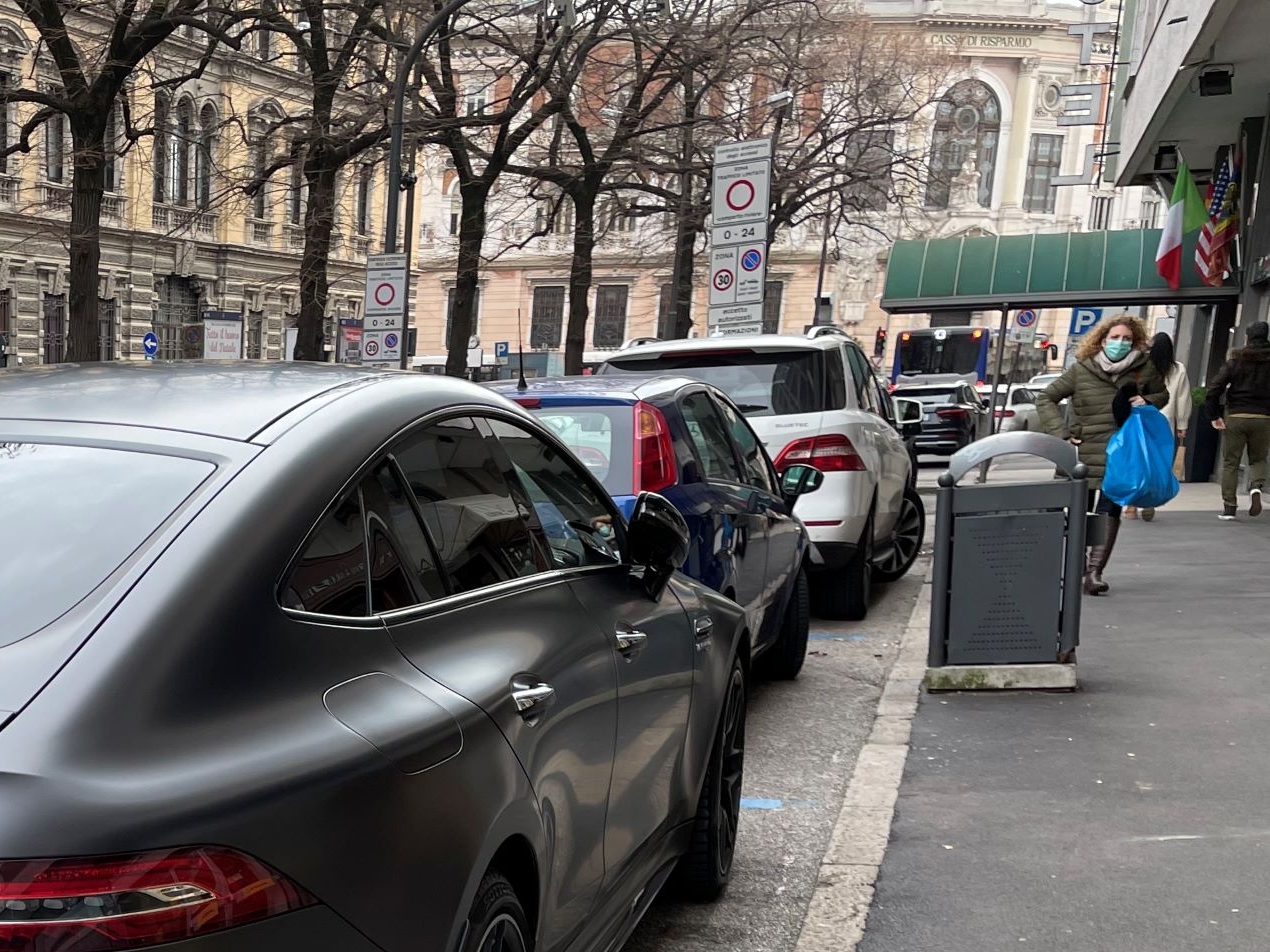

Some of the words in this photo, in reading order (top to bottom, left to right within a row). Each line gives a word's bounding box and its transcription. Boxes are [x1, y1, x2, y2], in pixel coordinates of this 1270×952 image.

[967, 36, 977, 46] DI
[980, 37, 1032, 48] RISPARMIO
[724, 230, 731, 239] 0
[741, 227, 755, 237] 24
[717, 274, 730, 286] 30
[1074, 310, 1097, 334] P
[496, 343, 507, 357] P
